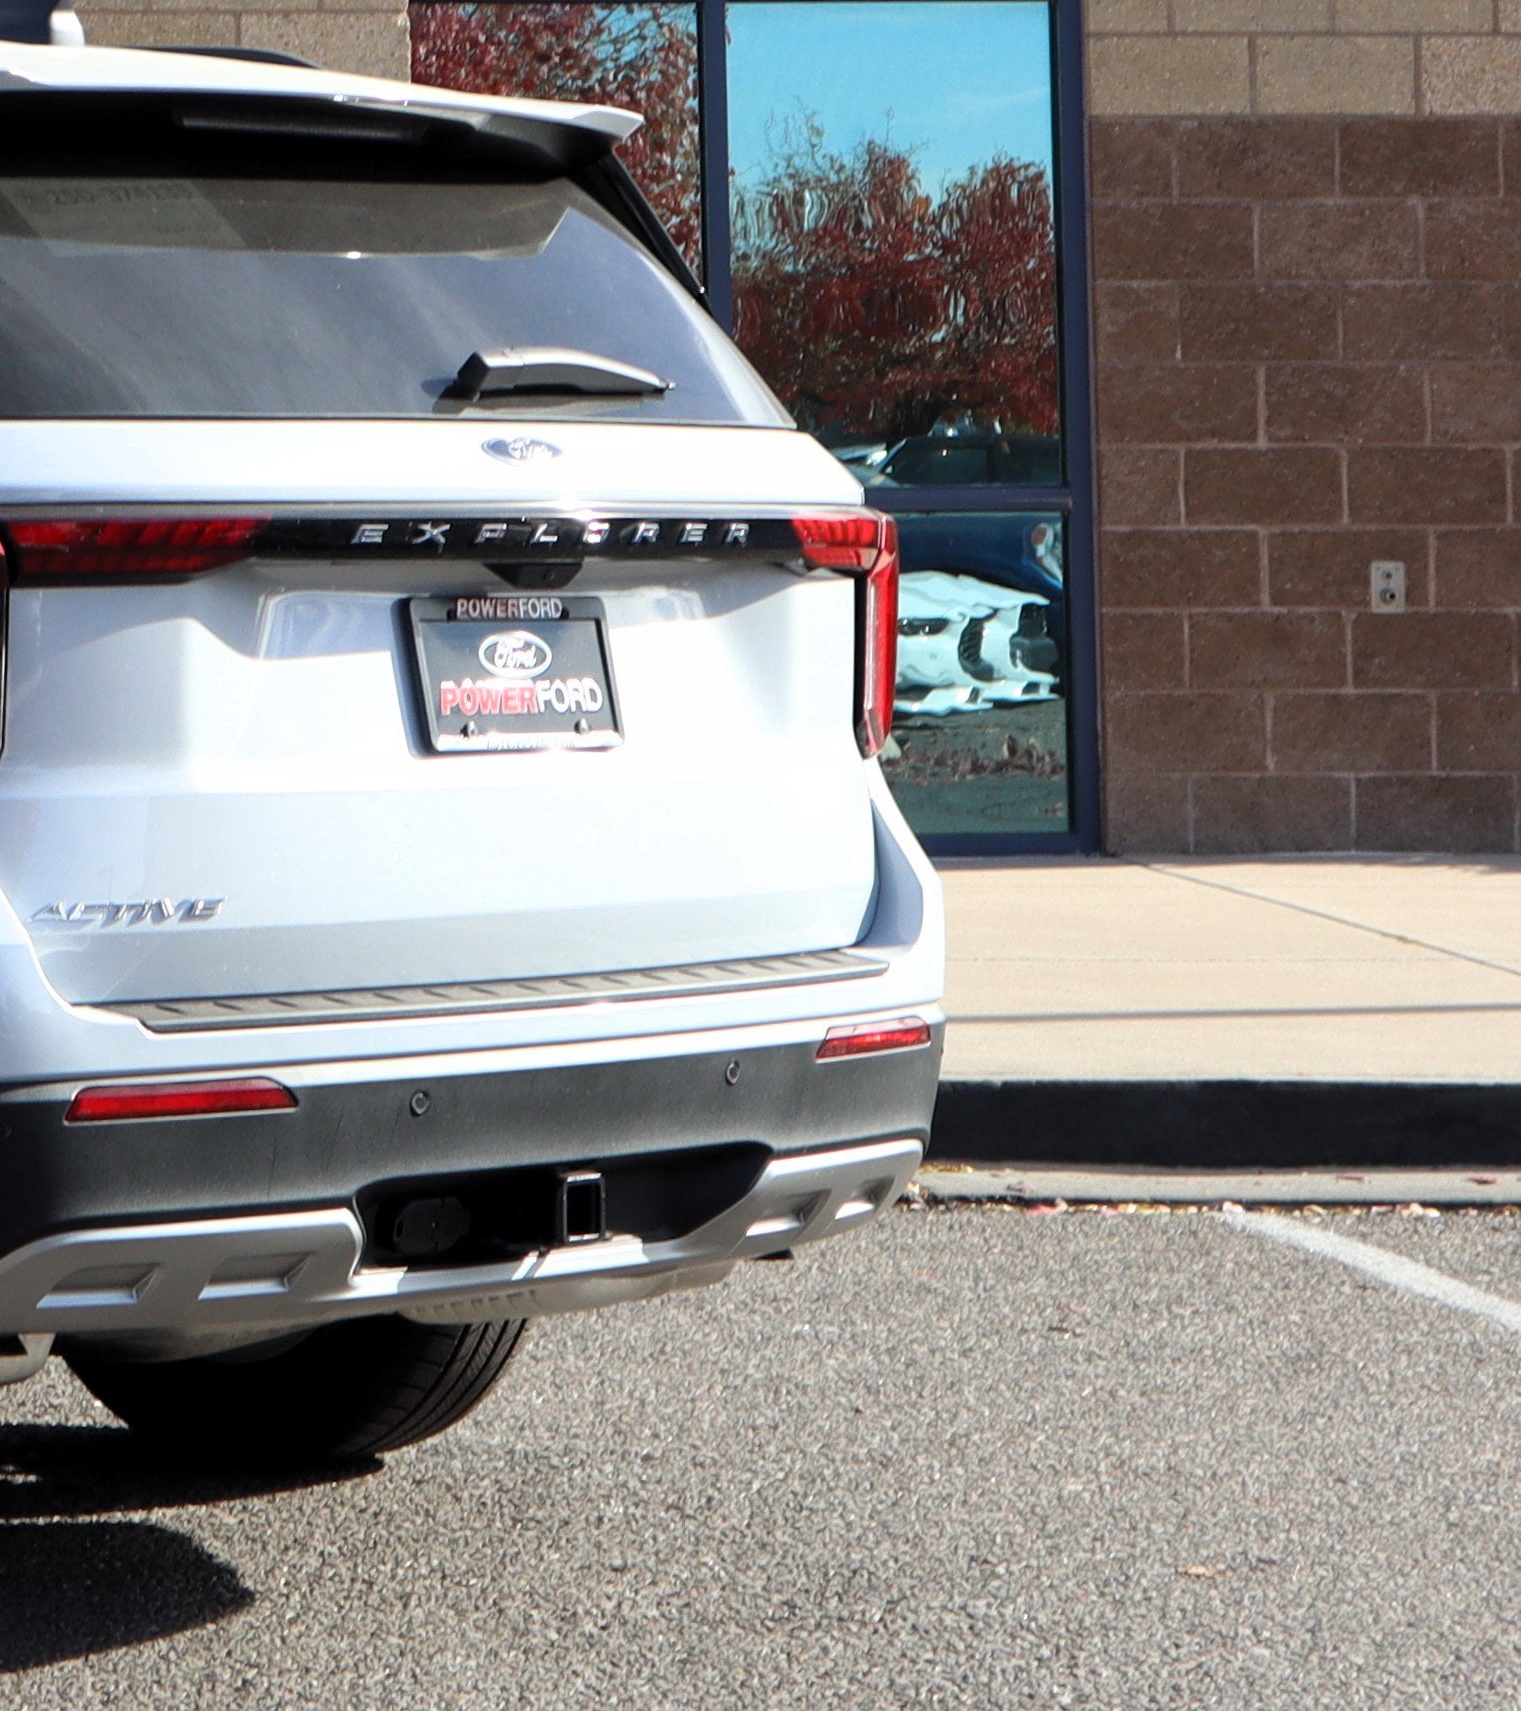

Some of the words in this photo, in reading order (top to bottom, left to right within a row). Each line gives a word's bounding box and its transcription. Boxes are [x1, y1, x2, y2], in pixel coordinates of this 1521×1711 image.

[351, 520, 751, 553] EXPLORER
[456, 597, 563, 620] POWERFORD
[493, 637, 538, 669] Ford
[439, 677, 604, 716] POWERFORD
